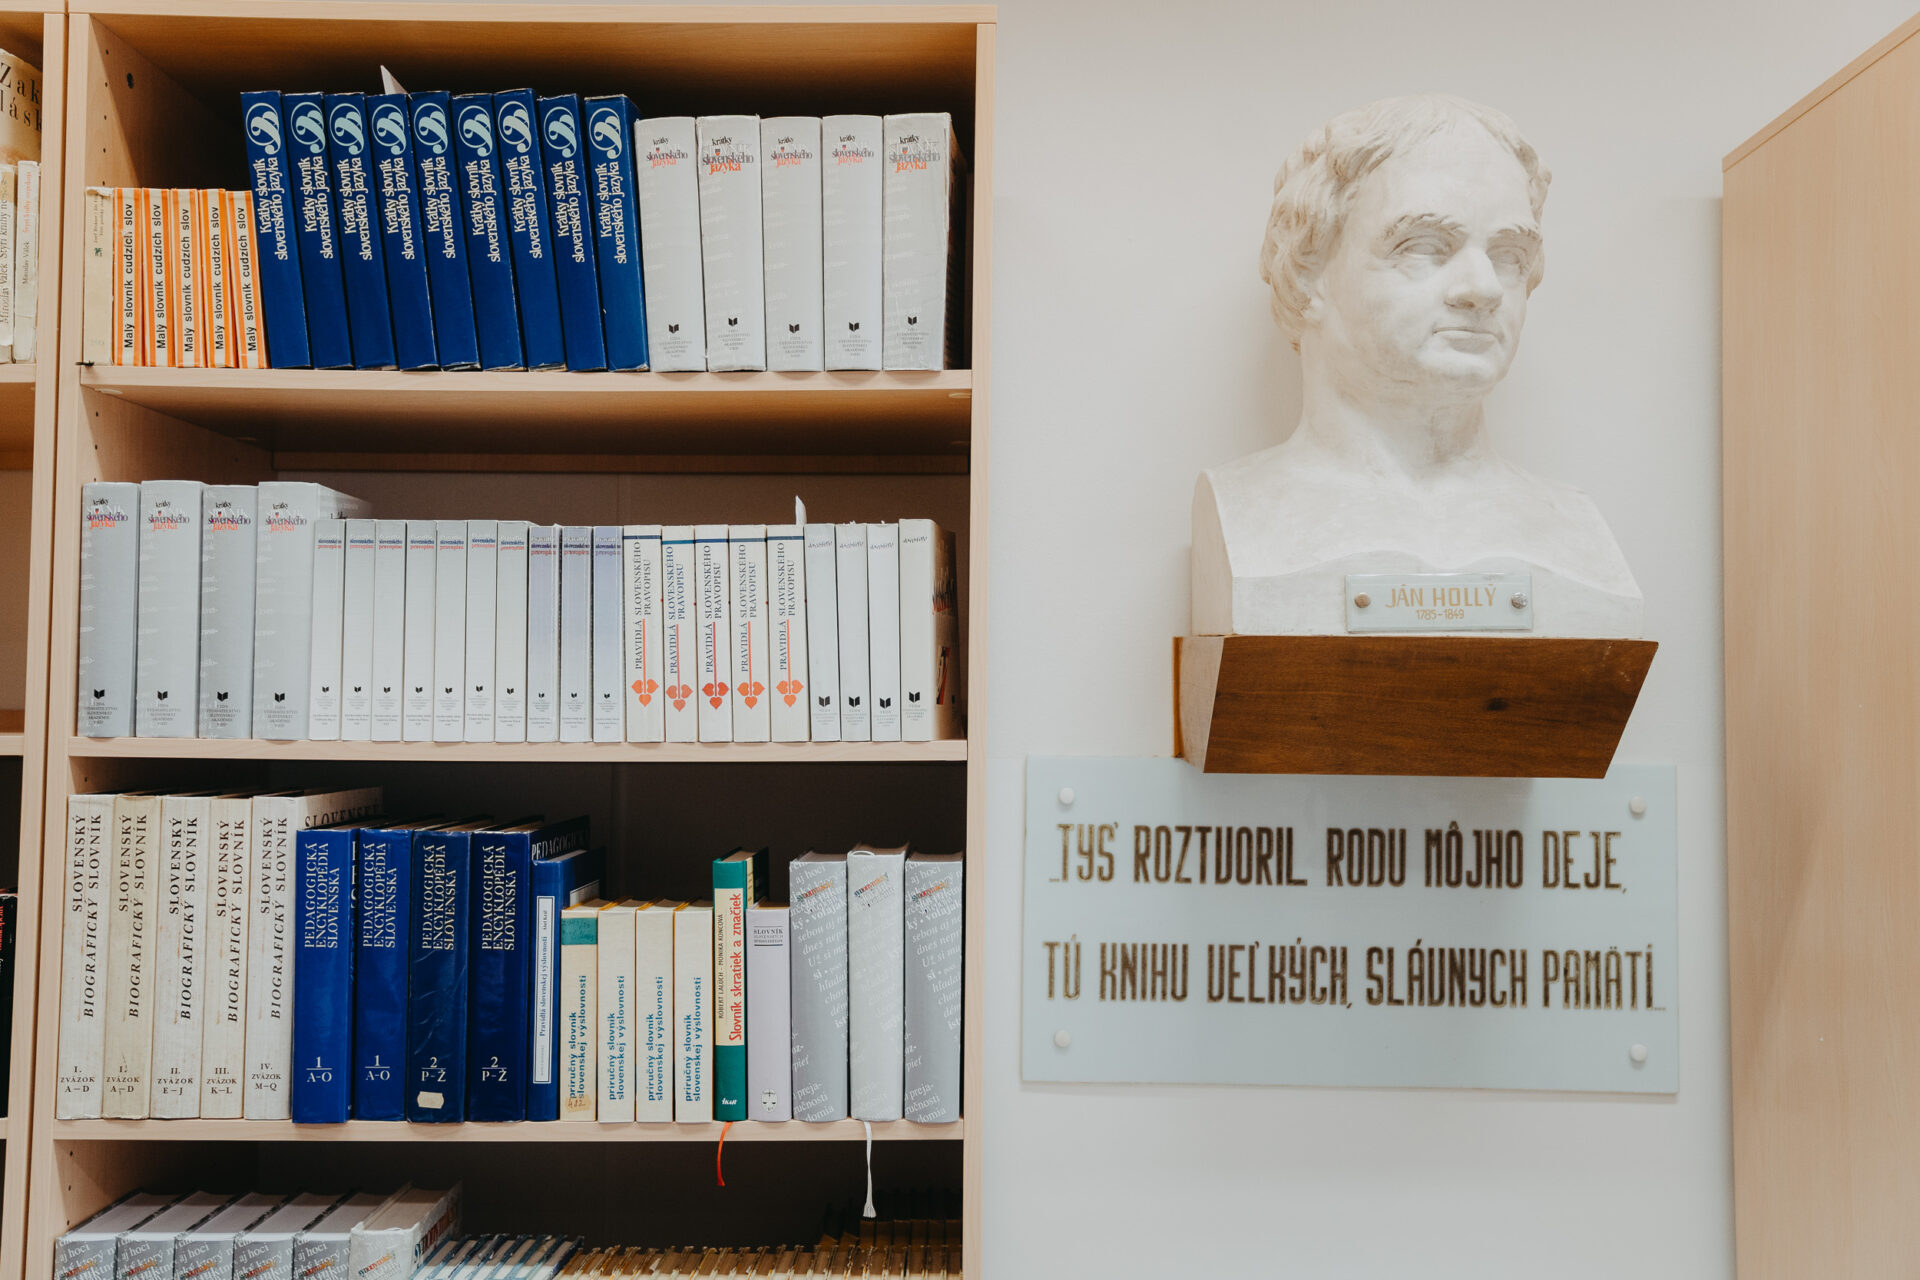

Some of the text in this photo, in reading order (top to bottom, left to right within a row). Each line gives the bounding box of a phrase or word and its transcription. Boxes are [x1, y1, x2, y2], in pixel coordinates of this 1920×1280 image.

[253, 158, 272, 234] Krátky slovník
[267, 157, 288, 260] slovenského jazyka
[298, 156, 318, 233] Krátky slovník
[312, 156, 333, 259] slovenského jazyka
[337, 158, 357, 234] Krátky slovník
[352, 157, 372, 260] slovenského jazyka
[379, 158, 399, 234] Krátky slovník
[394, 157, 415, 260] slovenského jazyka
[465, 160, 485, 236] Krátky slovník
[480, 158, 500, 262] slovenského jazyka
[506, 157, 526, 233] Krátky slovník
[520, 155, 542, 259] slovenského jazyka
[595, 162, 613, 238] Krátky slovník
[608, 162, 626, 264] slovenského jazyka
[124, 231, 133, 274] cudzích
[124, 280, 133, 318] slovník
[152, 204, 167, 349] Malý slovník cudzích slov
[180, 208, 194, 352] Malý slovník cudzích slov
[211, 207, 225, 350] Malý slovník cudzích slov
[237, 207, 257, 351] Malý slovník cudzích slov
[124, 323, 134, 348] Malý
[633, 542, 642, 616] SLOVENSKÉHO
[643, 559, 651, 615] PRAVOPISU
[666, 546, 677, 674] PRAVIDLÁ SLOVENSKÉHO
[676, 563, 685, 620] PRAVOPISU
[703, 545, 713, 673] PRAVIDLÁ SLOVENSKÉHO
[713, 562, 722, 619] PRAVOPISU
[738, 544, 748, 672] PRAVIDLÁ SLOVENSKÉHO
[748, 561, 757, 618] PRAVOPISU
[777, 542, 787, 670] PRAVIDLÁ SLOVENSKÉHO
[787, 560, 795, 616] PRAVOPISU
[1385, 584, 1496, 608] JÁN HOLLÝ
[72, 814, 86, 912] SLOVENSKÝ
[118, 814, 133, 912] SLOVENSKÝ
[169, 817, 183, 914] SLOVENSKÝ
[217, 820, 230, 917] SLOVENSKÝ
[260, 817, 273, 914] SLOVENSKÝ
[304, 842, 317, 948] PEDAGOGICKÁ
[315, 843, 328, 948] ENCYKLOPÉDIA
[363, 843, 375, 947] PEDAGOGICKÁ
[374, 843, 386, 947] ENCYKLOPÉDIA
[422, 844, 435, 949] PEDAGOGICKÁ
[433, 845, 446, 949] ENCYKLOPÉDIA
[482, 845, 494, 949] PEDAGOGICKÁ
[493, 846, 505, 950] ENCYKLOPÉDIA
[1326, 827, 1406, 888] RODU
[1424, 820, 1524, 889] MÔJHO
[1542, 830, 1627, 893] DEJE,
[84, 814, 101, 1018] BIOGRAFICKÝ SLOVNÍK
[129, 814, 147, 1018] BIOGRAFICKÝ SLOVNÍK
[180, 817, 198, 1020] BIOGRAFICKÝ SLOVNÍK
[228, 819, 245, 1023] BIOGRAFICKÝ SLOVNÍK
[270, 817, 288, 1020] BIOGRAFICKÝ SLOVNÍK
[327, 867, 340, 948] SLOVENSKA
[385, 868, 397, 948] SLOVENSKA
[444, 870, 456, 950] SLOVENSKA
[504, 870, 516, 950] SLOVENSKA
[729, 893, 741, 936] značiek
[730, 951, 742, 997] skratiek
[1042, 934, 1081, 1000] TÚ
[1099, 942, 1189, 1002] KNIHU
[316, 1056, 322, 1068] 1
[375, 1055, 380, 1067] 1
[430, 1056, 438, 1068] 2
[491, 1056, 499, 1068] 2
[568, 1012, 576, 1049] slovník
[577, 975, 587, 1098] slovenskej výslovnosti
[607, 1013, 615, 1051] slovník
[617, 976, 626, 1100] slovenskej výslovnosti
[646, 1014, 654, 1051] slovník
[656, 977, 665, 1101] slovenskej výslovnosti
[693, 977, 702, 1102] slovenskej výslovnosti
[729, 1001, 741, 1041] Slovník
[68, 1242, 89, 1259] hoci
